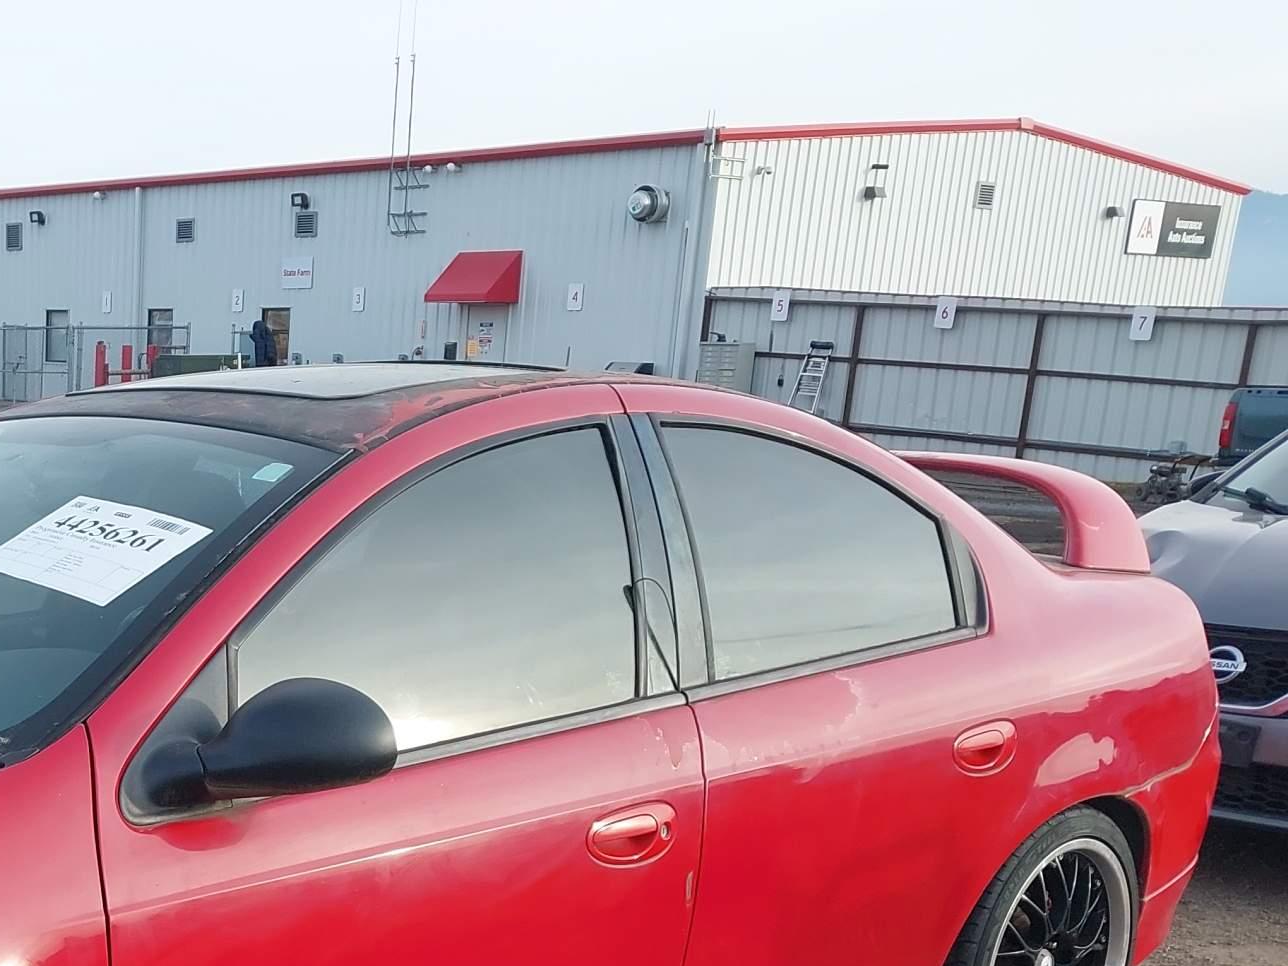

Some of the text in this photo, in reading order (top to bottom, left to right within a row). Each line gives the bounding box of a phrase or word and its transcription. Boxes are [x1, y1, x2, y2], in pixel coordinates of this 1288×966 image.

[235, 295, 239, 305] 2
[356, 294, 360, 304] 3
[572, 291, 578, 302] 4
[777, 300, 783, 312] 5
[942, 306, 948, 319] 6
[1139, 316, 1147, 330] 7
[54, 515, 165, 552] 44256261
